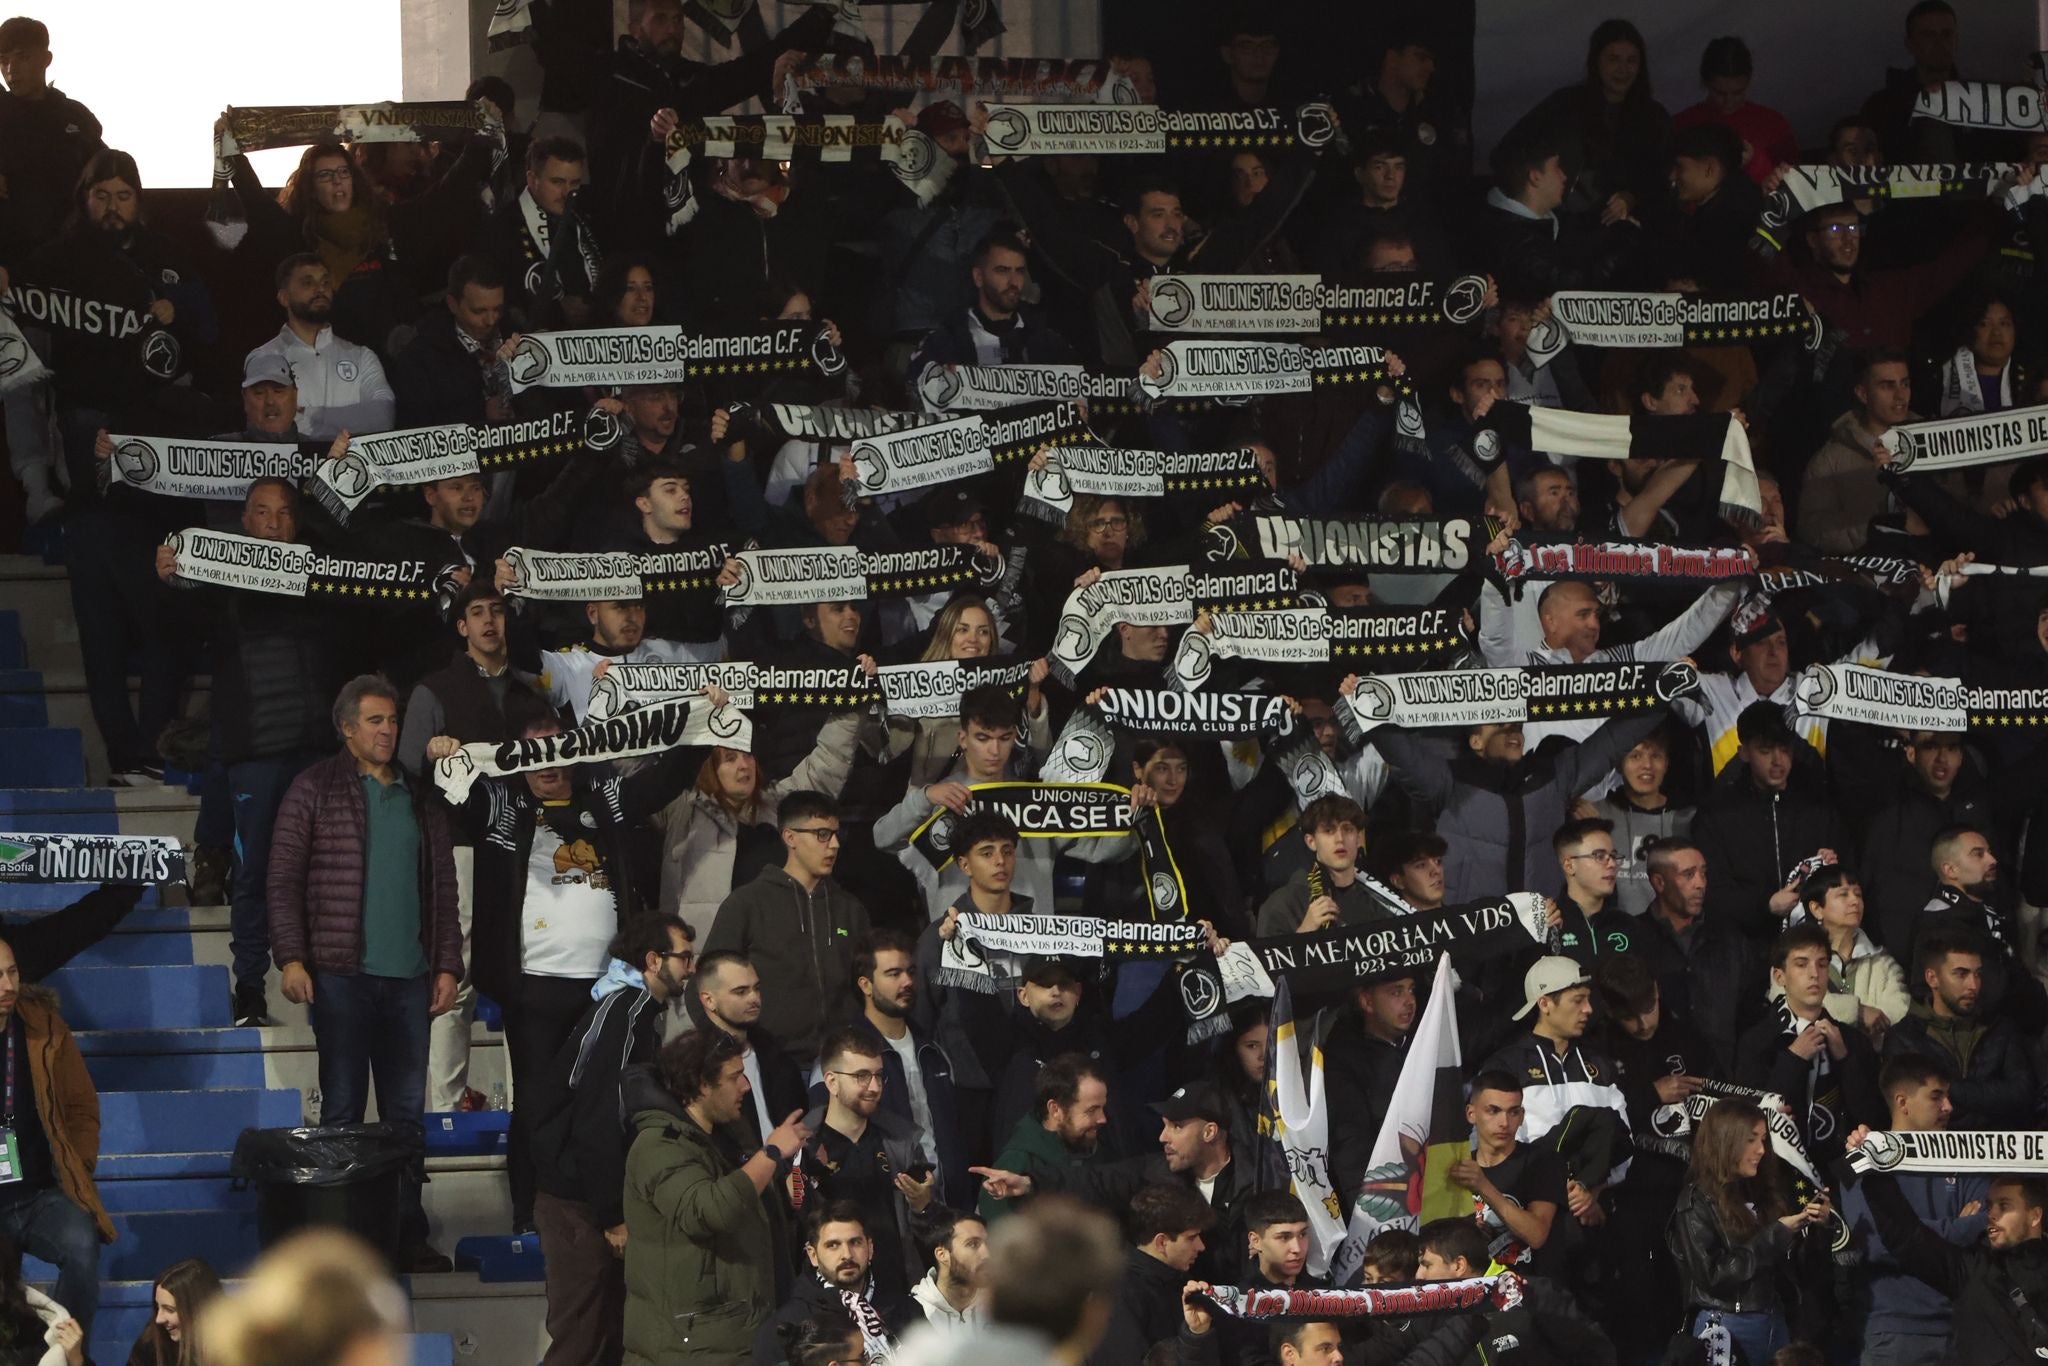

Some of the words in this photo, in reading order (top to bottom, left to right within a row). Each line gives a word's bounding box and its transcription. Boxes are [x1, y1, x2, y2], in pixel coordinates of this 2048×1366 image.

[1037, 109, 1133, 133] UNIONISTAS
[1134, 111, 1156, 133] de
[1158, 110, 1253, 132] Salamanca
[1255, 108, 1288, 130] C.F.
[1201, 283, 1292, 311] UNIONISTAS
[1294, 285, 1314, 310] de
[1315, 283, 1405, 310] Salamanca
[1407, 281, 1435, 307] C.F.
[1559, 298, 1652, 325] UNIONISTAS
[1655, 301, 1675, 325] de
[1677, 299, 1768, 324] Salamanca
[1772, 293, 1800, 319] C.F.
[556, 335, 652, 364] UNIONISTAS
[654, 341, 675, 361] de
[677, 333, 772, 360] Salamanca
[775, 328, 803, 354] C.F.
[1186, 348, 1279, 376] UNIONISTAS
[1281, 350, 1301, 373] de
[965, 366, 1056, 396] UNIONISTAS
[1059, 371, 1079, 397] de
[361, 431, 448, 467] UNIONISTAS
[449, 432, 467, 453] de
[466, 418, 550, 451] Salamanca
[553, 411, 576, 435] C.F.
[888, 423, 965, 468] UNIONISTAS
[966, 428, 980, 451] de
[981, 411, 1054, 449] Salamanca
[1056, 403, 1082, 427] C.F.
[1928, 421, 2023, 457] UNIONISTAS
[2028, 416, 2048, 443] DE
[168, 446, 265, 477] UNIONISTAS
[267, 454, 289, 476] de
[1136, 453, 1155, 475] de
[1156, 450, 1235, 476] Salamanca
[155, 480, 166, 490] IN
[1255, 515, 1471, 570] UNIONISTAS
[191, 535, 282, 574] UNIONISTAS
[283, 550, 304, 573] de
[304, 550, 398, 582] Salamanca
[399, 561, 427, 583] C.F.
[532, 557, 613, 580] UNIONISTAS
[614, 556, 632, 577] de
[632, 550, 708, 576] Salamanca
[758, 555, 839, 582] UNIONISTAS
[841, 556, 858, 578] de
[857, 551, 939, 576] Salamanca
[1077, 575, 1162, 617] UNIONISTAS
[1164, 577, 1184, 600] de
[1184, 573, 1276, 600] Salamanca
[1299, 615, 1321, 640] de
[1322, 614, 1416, 639] Salamanca
[1420, 610, 1448, 636] C.F.
[619, 665, 721, 690] UNIONISTAS
[723, 670, 745, 690] de
[748, 664, 848, 689] Salamanca
[933, 675, 953, 696] de
[1400, 674, 1496, 704] UNIONISTAS
[1499, 675, 1520, 700] de
[1520, 671, 1615, 698] Salamanca
[1619, 665, 1646, 692] C.F.
[1845, 670, 1935, 707] UNIONISTAS
[1936, 687, 1956, 709] de
[1832, 704, 1843, 714] IN
[1203, 722, 1235, 732] CLUB
[1240, 722, 1256, 732] DE
[1070, 805, 1107, 829] SE
[39, 847, 170, 881] UNIONISTAS
[1069, 918, 1092, 936] de
[1096, 919, 1196, 942] Salamanca
[1460, 903, 1513, 935] VDS
[1355, 959, 1386, 977] 1923
[1401, 948, 1434, 967] 2013
[1916, 1133, 2017, 1160] UNIONISTAS
[2024, 1135, 2044, 1160] DE
